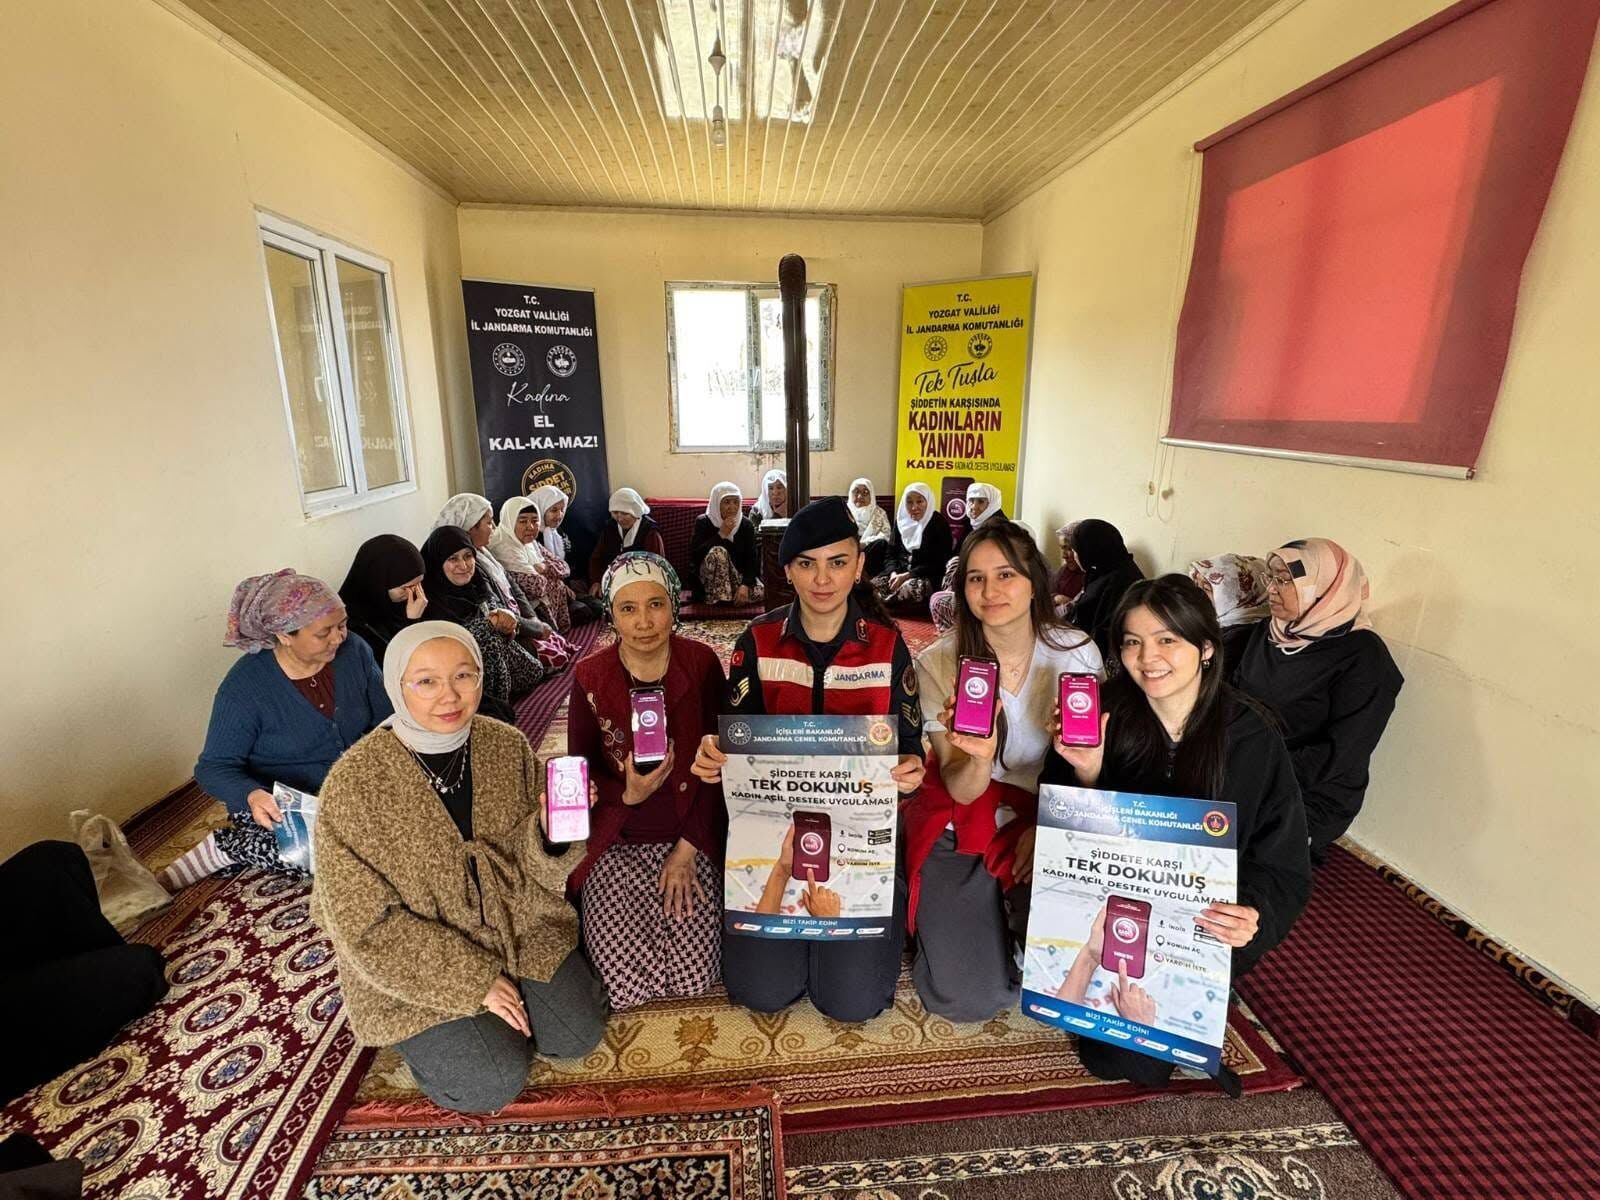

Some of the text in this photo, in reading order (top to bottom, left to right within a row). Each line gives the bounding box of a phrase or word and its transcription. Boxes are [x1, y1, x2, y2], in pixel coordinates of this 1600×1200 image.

[523, 295, 540, 305] T.C.
[956, 293, 972, 302] T.C.
[495, 308, 570, 321] YOZGAT VALİLİĞİ
[928, 304, 1000, 319] YOZGAT VALİLİĞİ
[471, 319, 593, 337] İL JANDARMA KOMUTANLIĞI
[906, 317, 1024, 334] İL JANDARMA KOMUTANLIĞI
[914, 361, 999, 396] Tek Tuşla
[506, 381, 570, 414] Kadına
[910, 396, 1000, 410] ŞİDDETİN KARŞISINDA
[533, 415, 554, 428] EL
[909, 411, 1002, 432] KADINLARIN
[489, 436, 598, 451] KAL-KA-MAZ!
[919, 432, 985, 459] YANINDA
[906, 459, 954, 470] KADES
[834, 670, 885, 682] JANDARMA
[806, 727, 844, 735] BAKANLIĞI
[818, 734, 867, 743] KOMUTANLIĞI
[770, 768, 851, 781] ŞİDDETE KARŞI
[749, 778, 873, 797] TEK DOKUNUŞ
[731, 791, 761, 800] KADIN
[788, 796, 826, 805] DESTEK
[829, 797, 893, 806] UYGULAMASI
[1133, 800, 1147, 809] T.C.
[1135, 809, 1178, 820] BAKANLIĞI
[1121, 816, 1147, 826] GENEL
[1148, 819, 1203, 831] KOMUTANLIĞI
[1090, 848, 1183, 871] ŞİDDETE KARŞI
[1042, 868, 1077, 880] KADIN
[1107, 879, 1151, 895] DESTEK
[1065, 856, 1206, 893] TEK DOKUNUŞ
[1085, 1011, 1100, 1021] BİZİ
[1101, 1016, 1126, 1028] TAKİP
